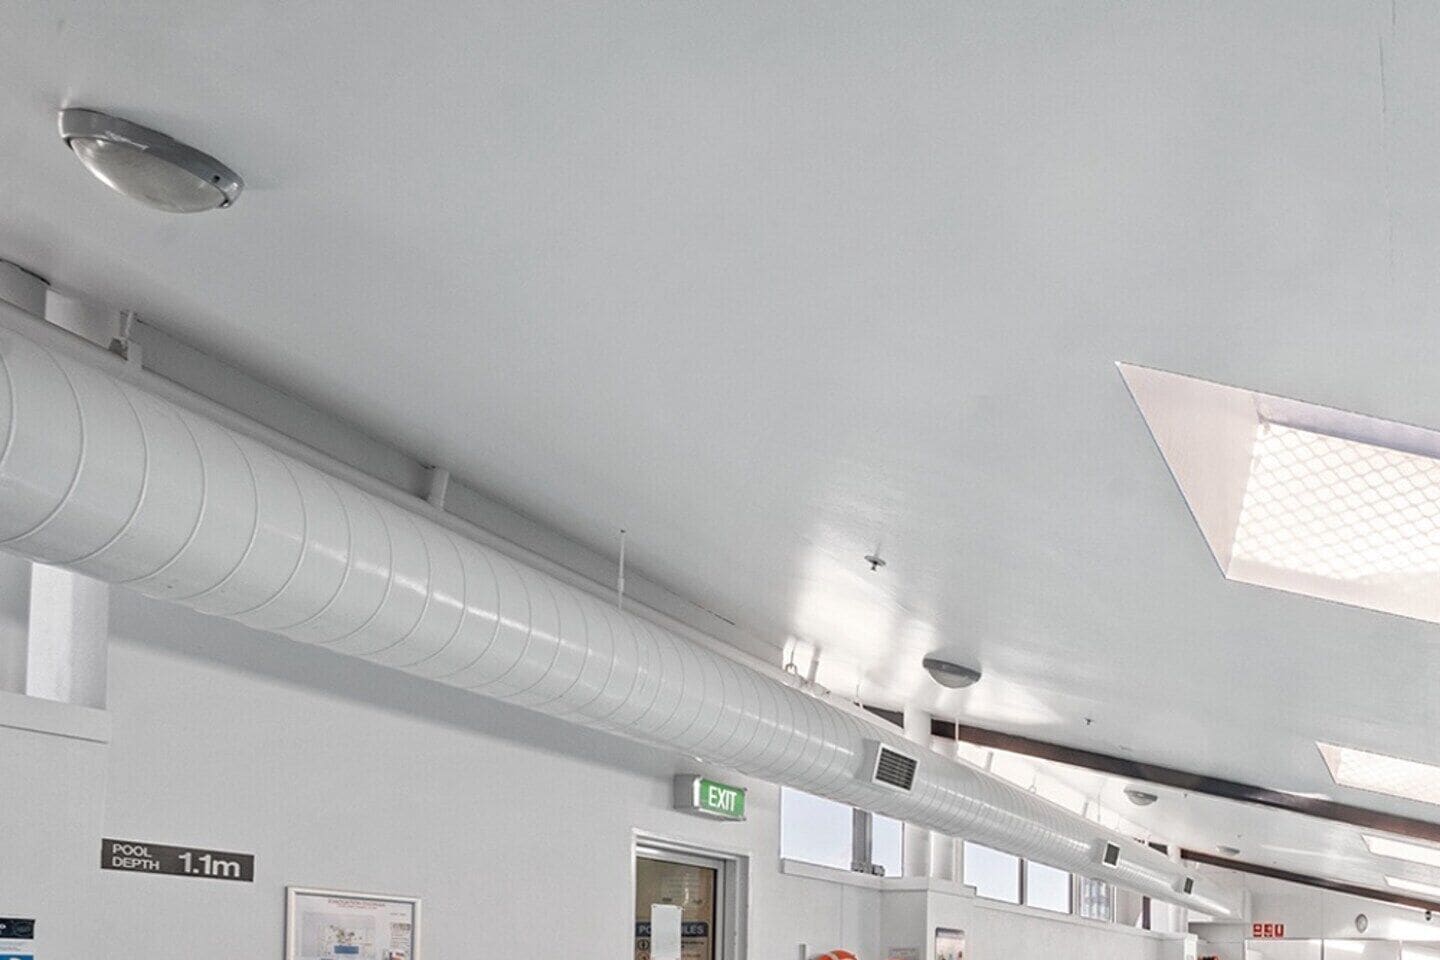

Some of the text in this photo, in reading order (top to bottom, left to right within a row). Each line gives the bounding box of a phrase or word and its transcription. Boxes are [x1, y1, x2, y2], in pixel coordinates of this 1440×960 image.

[709, 785, 738, 812] EXIT
[111, 843, 153, 858] POOL
[111, 856, 160, 871] DEPTH
[177, 851, 241, 878] 1.1m
